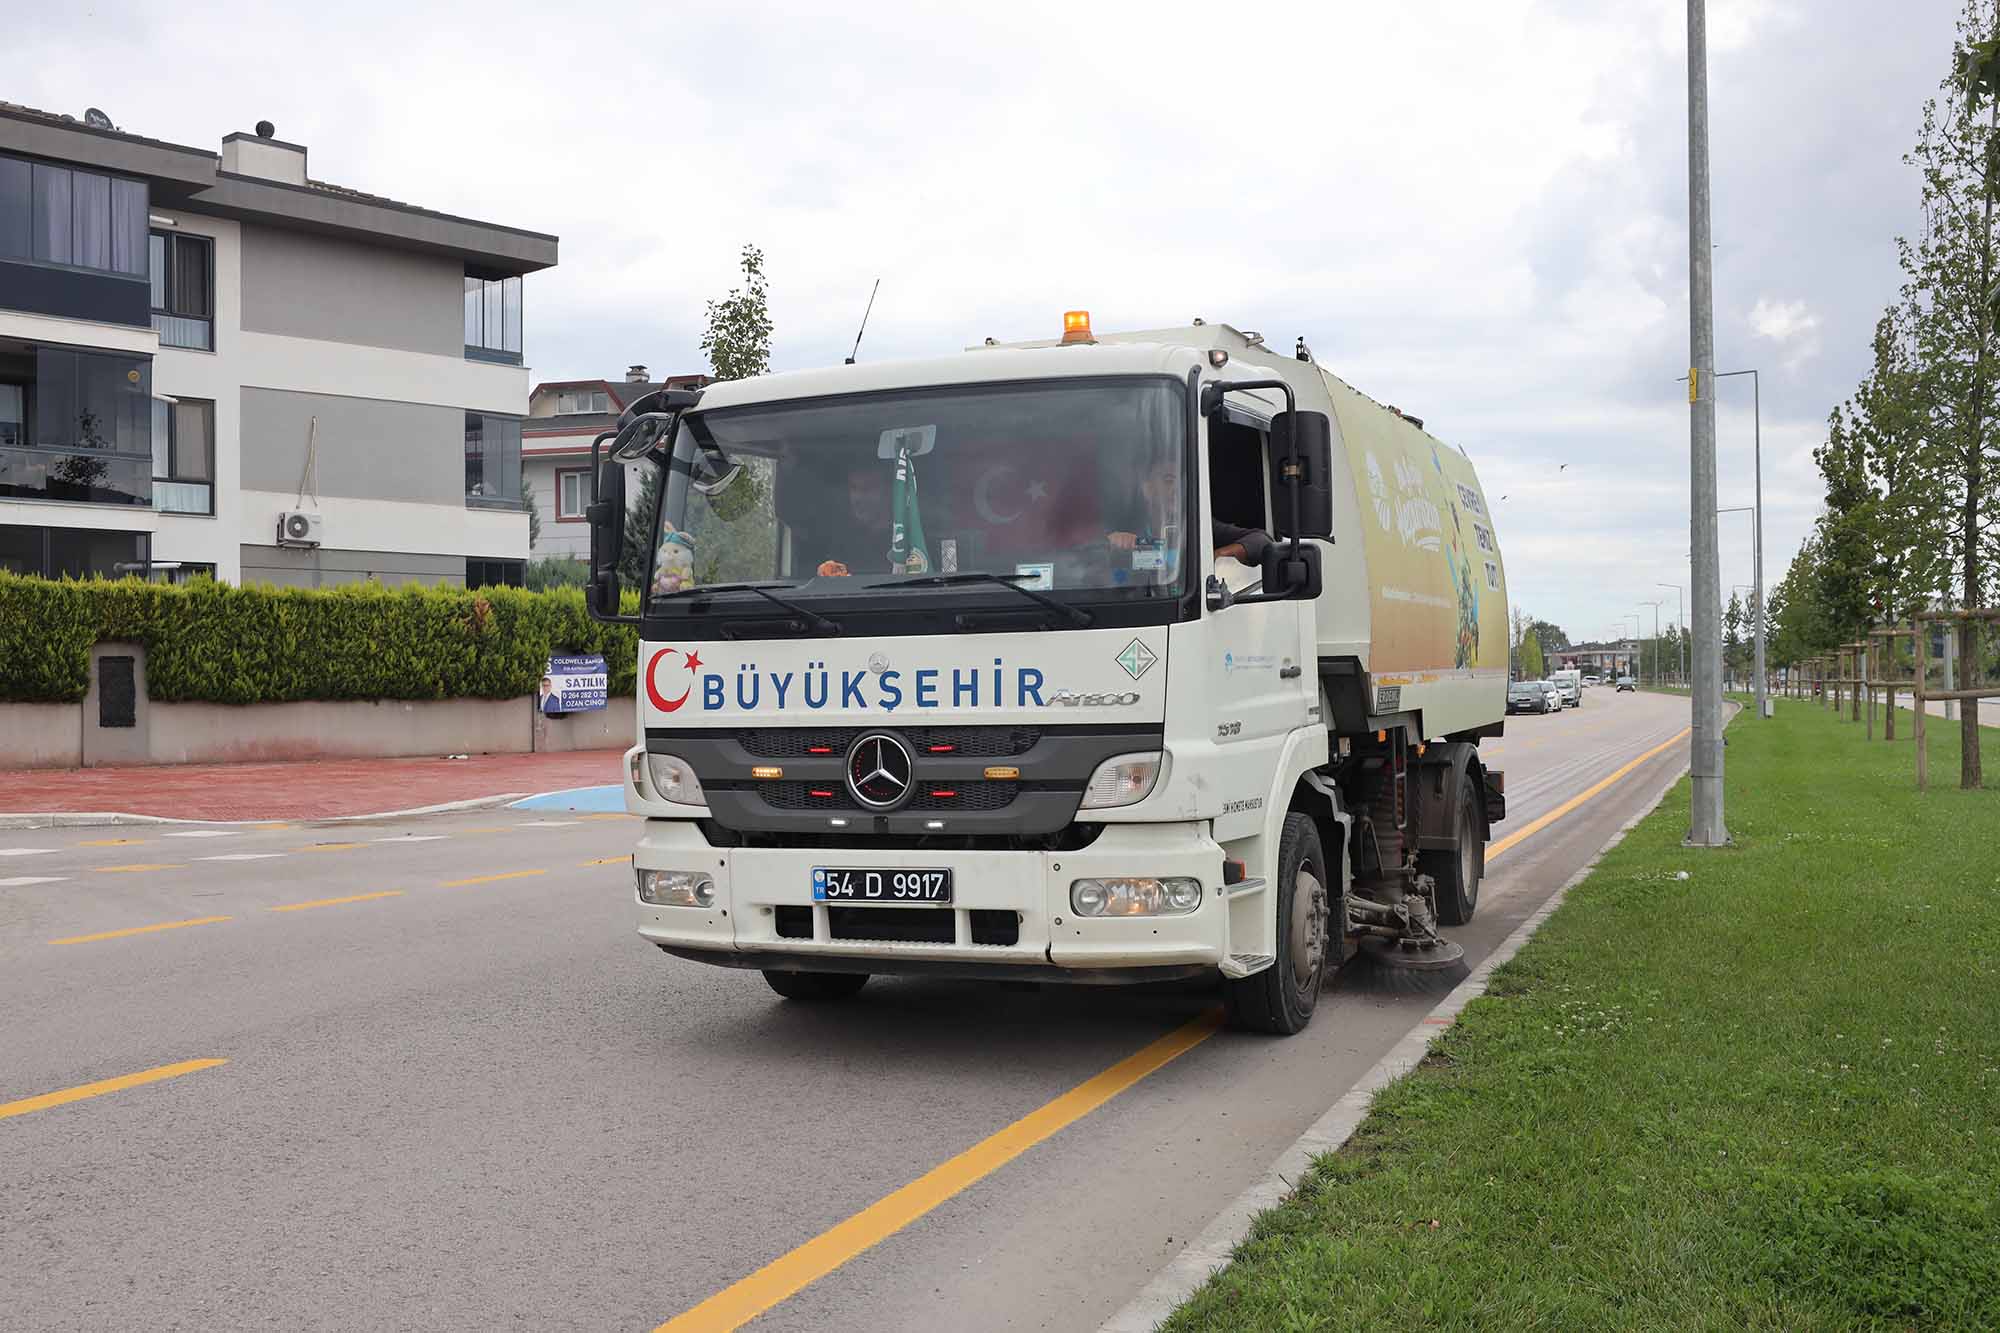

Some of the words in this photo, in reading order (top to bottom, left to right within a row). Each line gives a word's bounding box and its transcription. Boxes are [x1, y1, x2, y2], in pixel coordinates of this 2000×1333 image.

[566, 677, 605, 687] SATILIK
[703, 658, 1044, 712] BÜYÜKŞEHİR
[826, 872, 854, 897] 54
[865, 872, 882, 897] D
[893, 873, 944, 898] 9917
